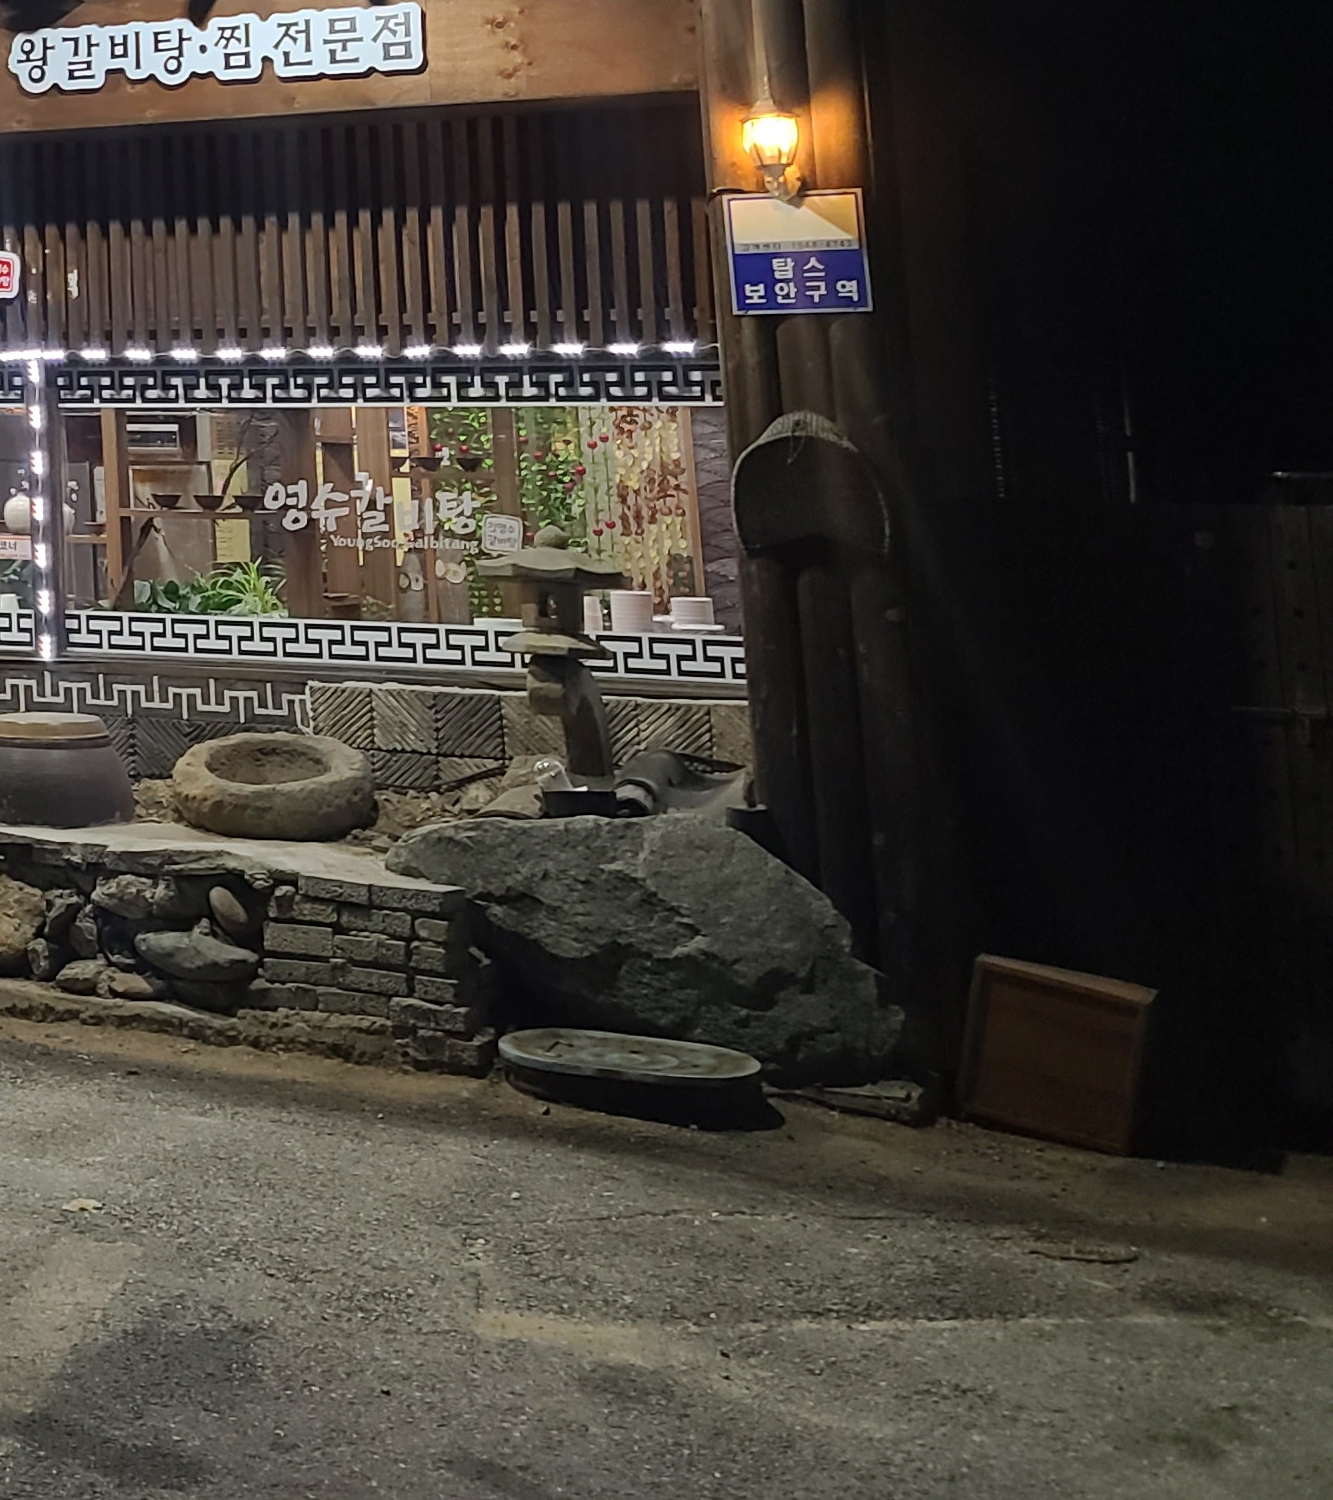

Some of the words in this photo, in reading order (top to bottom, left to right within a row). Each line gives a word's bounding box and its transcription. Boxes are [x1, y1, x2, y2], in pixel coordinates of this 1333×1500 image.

[272, 16, 416, 73] 전문점
[744, 279, 859, 304] 보안구역
[263, 479, 481, 534] 영수갈비탕
